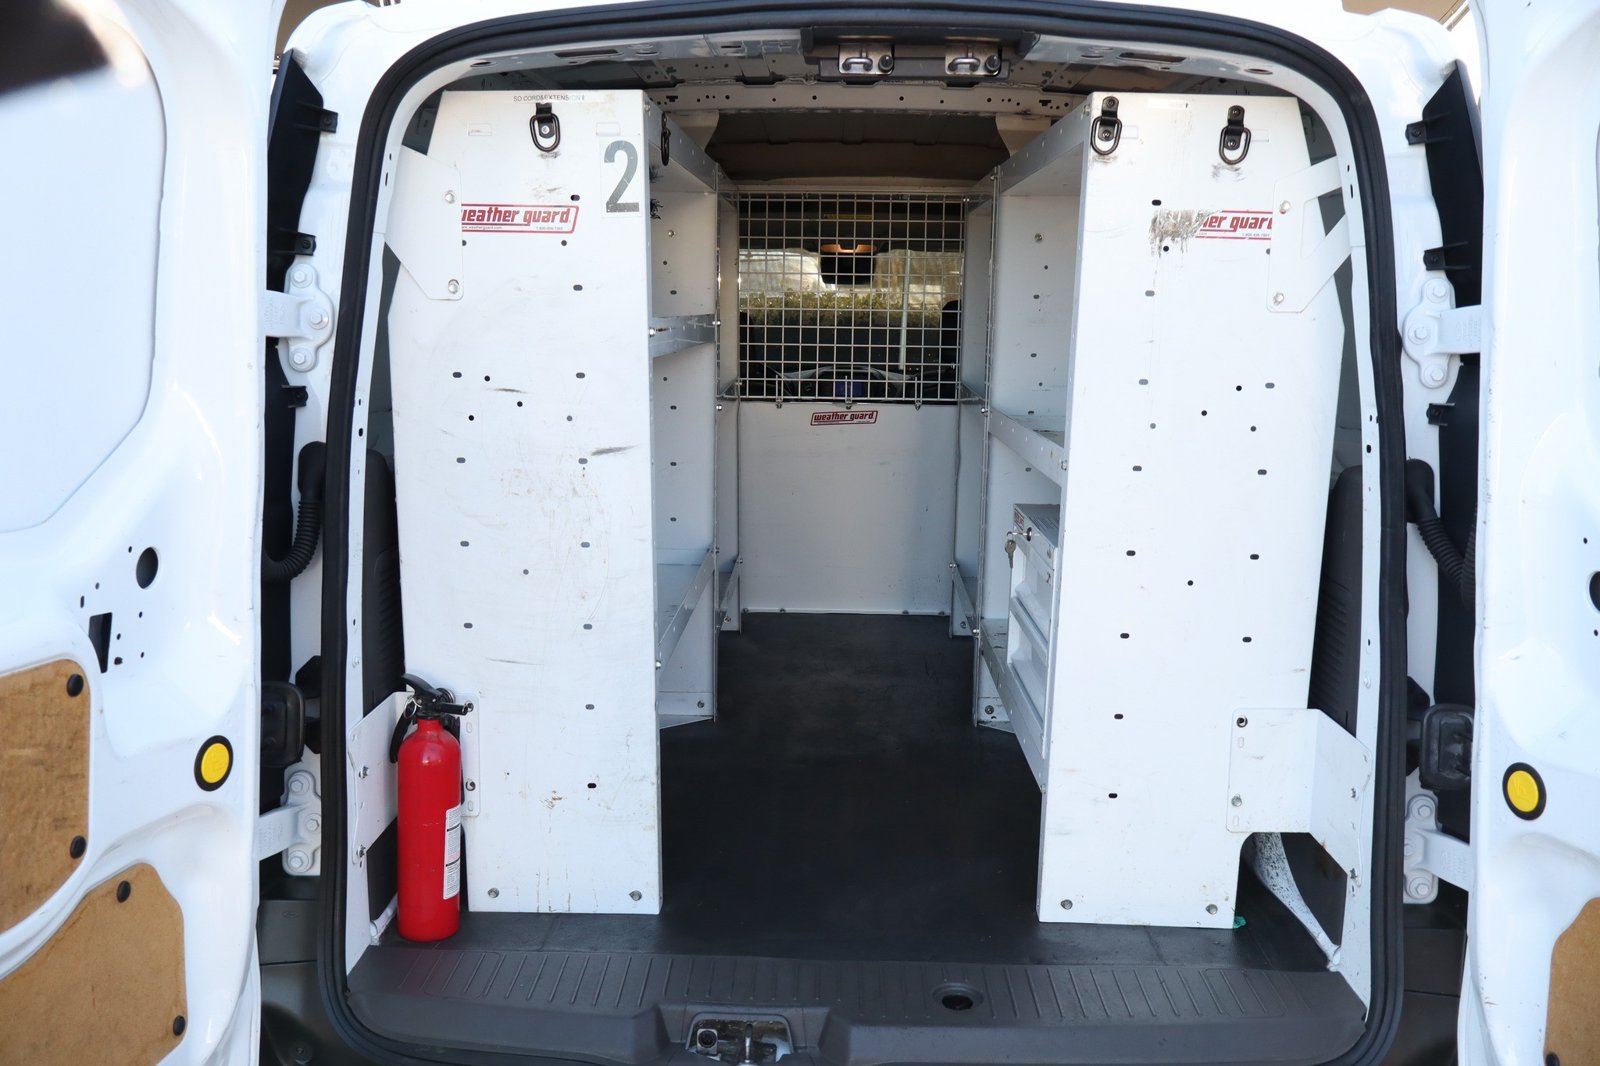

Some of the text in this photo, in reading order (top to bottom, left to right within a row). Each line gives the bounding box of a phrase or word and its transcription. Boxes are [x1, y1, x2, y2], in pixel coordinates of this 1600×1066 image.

[604, 140, 639, 213] 2
[523, 208, 571, 224] guard
[814, 411, 874, 421] weather guard
